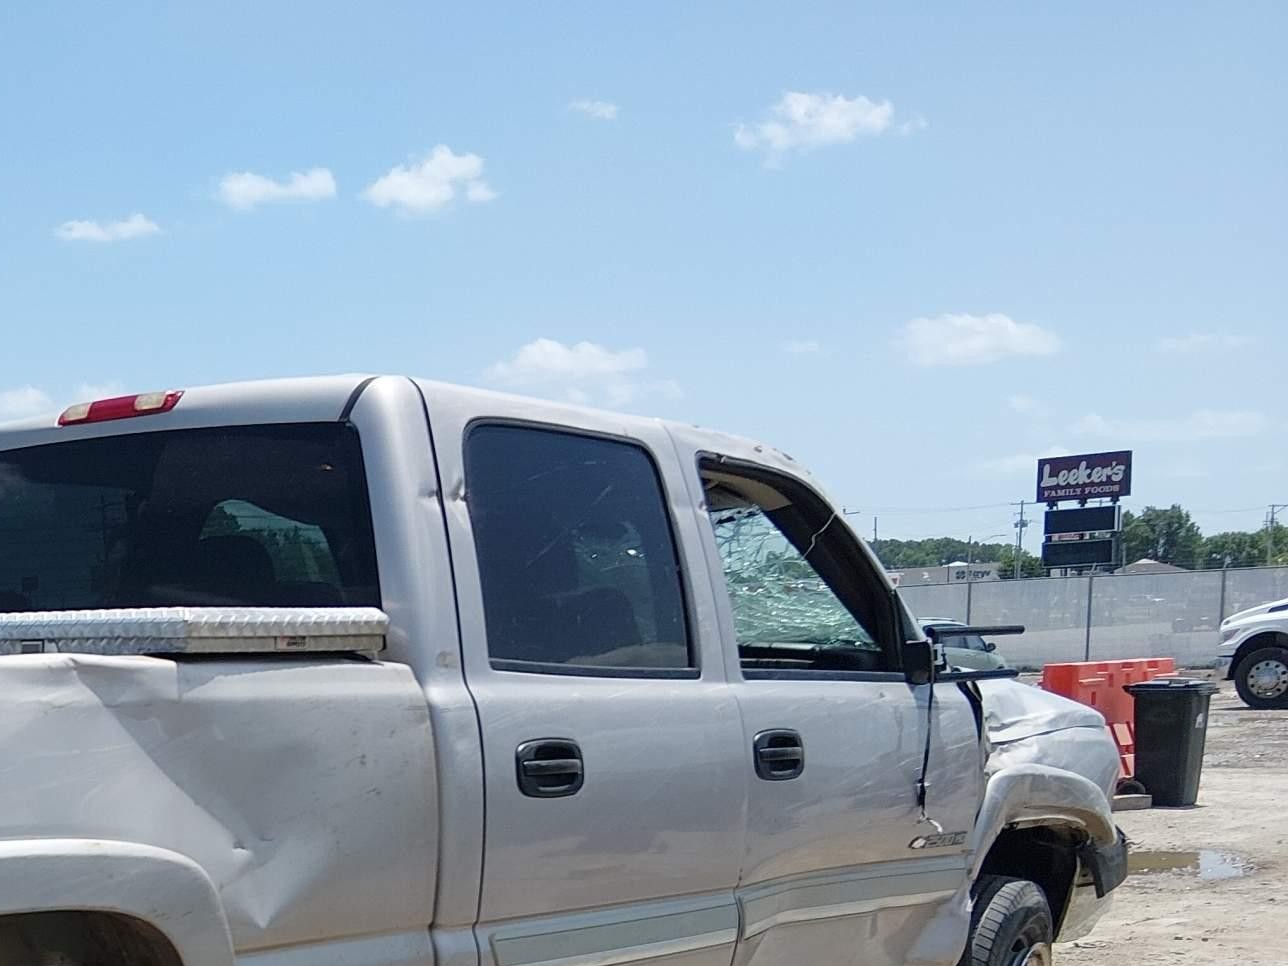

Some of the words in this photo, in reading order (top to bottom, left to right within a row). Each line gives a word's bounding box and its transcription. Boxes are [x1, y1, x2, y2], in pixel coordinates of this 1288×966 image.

[1041, 460, 1125, 487] Leeker's
[1044, 487, 1082, 498] FAMILY
[1084, 484, 1120, 495] FOODS
